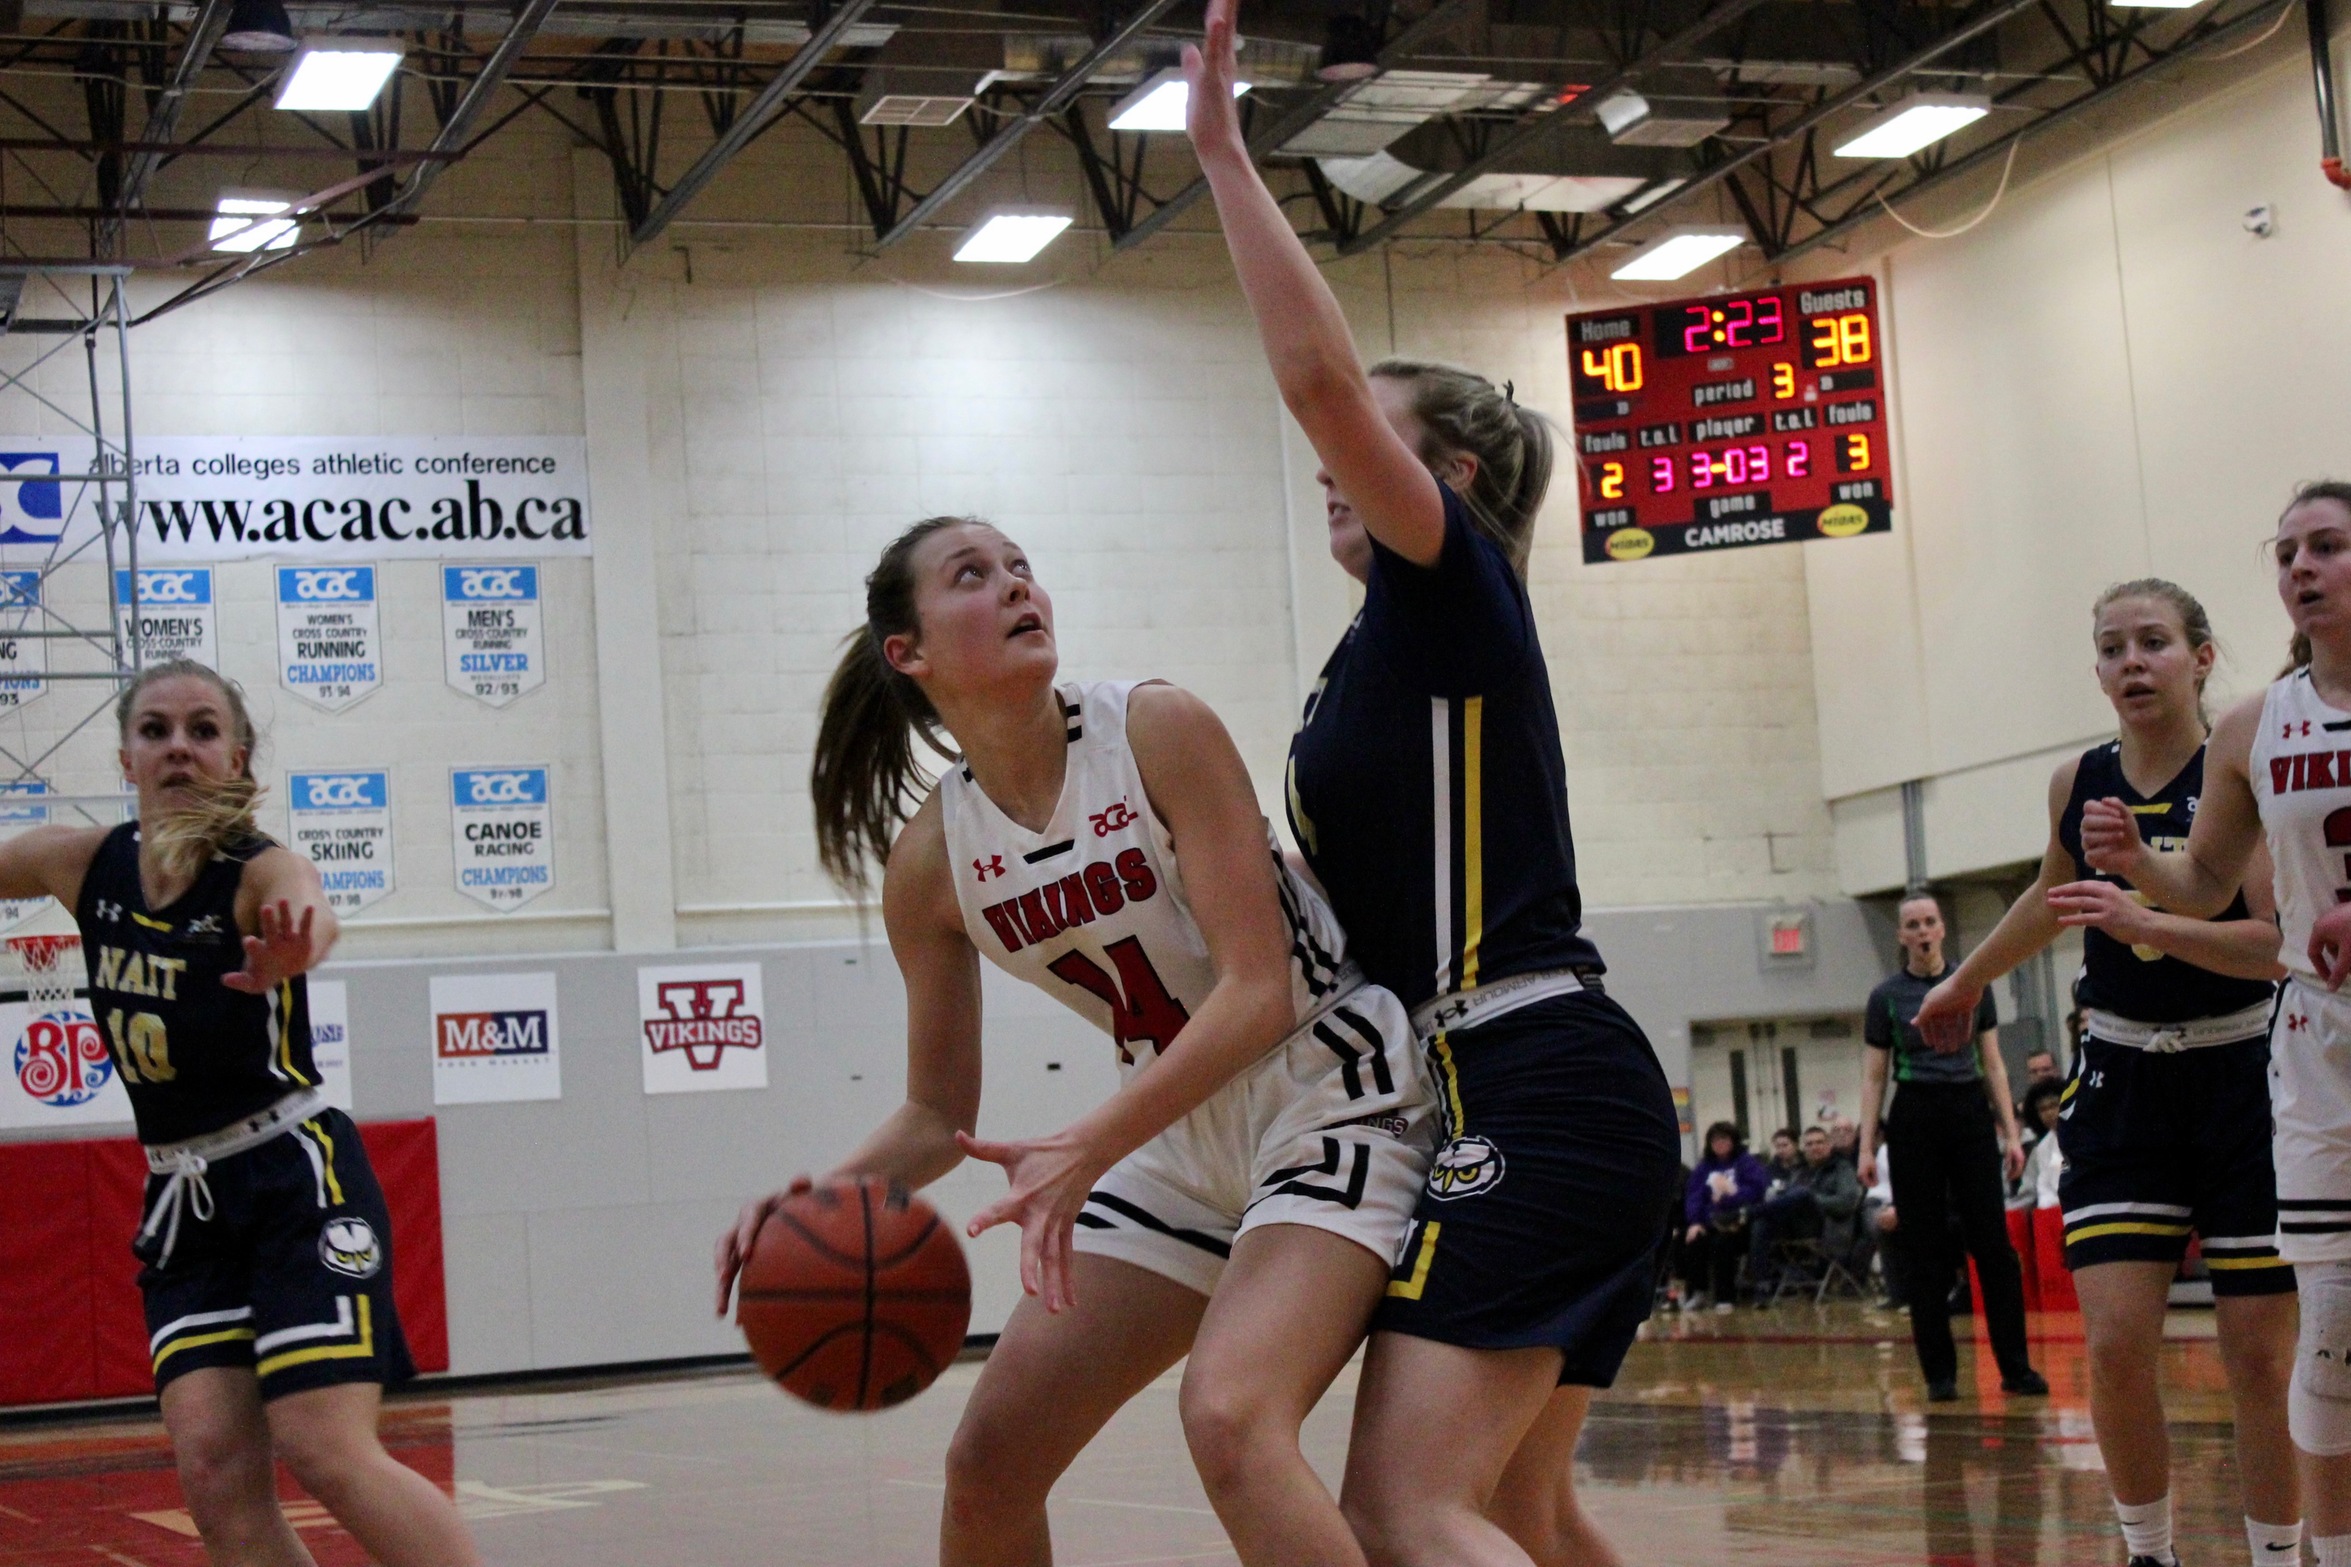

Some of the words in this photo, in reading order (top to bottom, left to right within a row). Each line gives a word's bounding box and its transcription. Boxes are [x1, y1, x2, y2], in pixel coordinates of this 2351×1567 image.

[1801, 289, 1865, 314] Guests
[1581, 320, 1631, 342] Home
[1684, 296, 1784, 352] 2:23
[1812, 313, 1871, 368] 38
[1582, 343, 1643, 392] 40
[1773, 362, 1795, 399] 3
[1695, 379, 1752, 407] period
[1696, 417, 1754, 442] player
[89, 453, 180, 476] alberta
[192, 453, 301, 481] colleges
[312, 453, 404, 475] athletic
[415, 451, 557, 475] conference
[1787, 441, 1808, 477] 2
[1848, 433, 1870, 471] 3
[1601, 462, 1624, 499] 2
[1653, 456, 1674, 493] 3
[93, 478, 588, 543] www.acac.ab.ca
[1709, 494, 1756, 518] game
[1684, 517, 1786, 547] CAMROSE
[306, 613, 353, 626] WOMEN'S
[467, 609, 515, 628] MEN'S
[297, 640, 366, 659] RUNNING
[460, 653, 529, 673] SILVER
[287, 664, 376, 684] CHAMPIONS
[465, 821, 542, 841] CANOE
[474, 842, 535, 857] RACING
[322, 869, 385, 891] AMPIONS
[461, 865, 548, 886] CHAMPIONS
[981, 847, 1157, 953] VIKINGS
[95, 944, 187, 1001] NAIT
[106, 1007, 178, 1083] 10
[443, 1015, 543, 1053] M&M
[648, 1018, 760, 1049] VIKINGS
